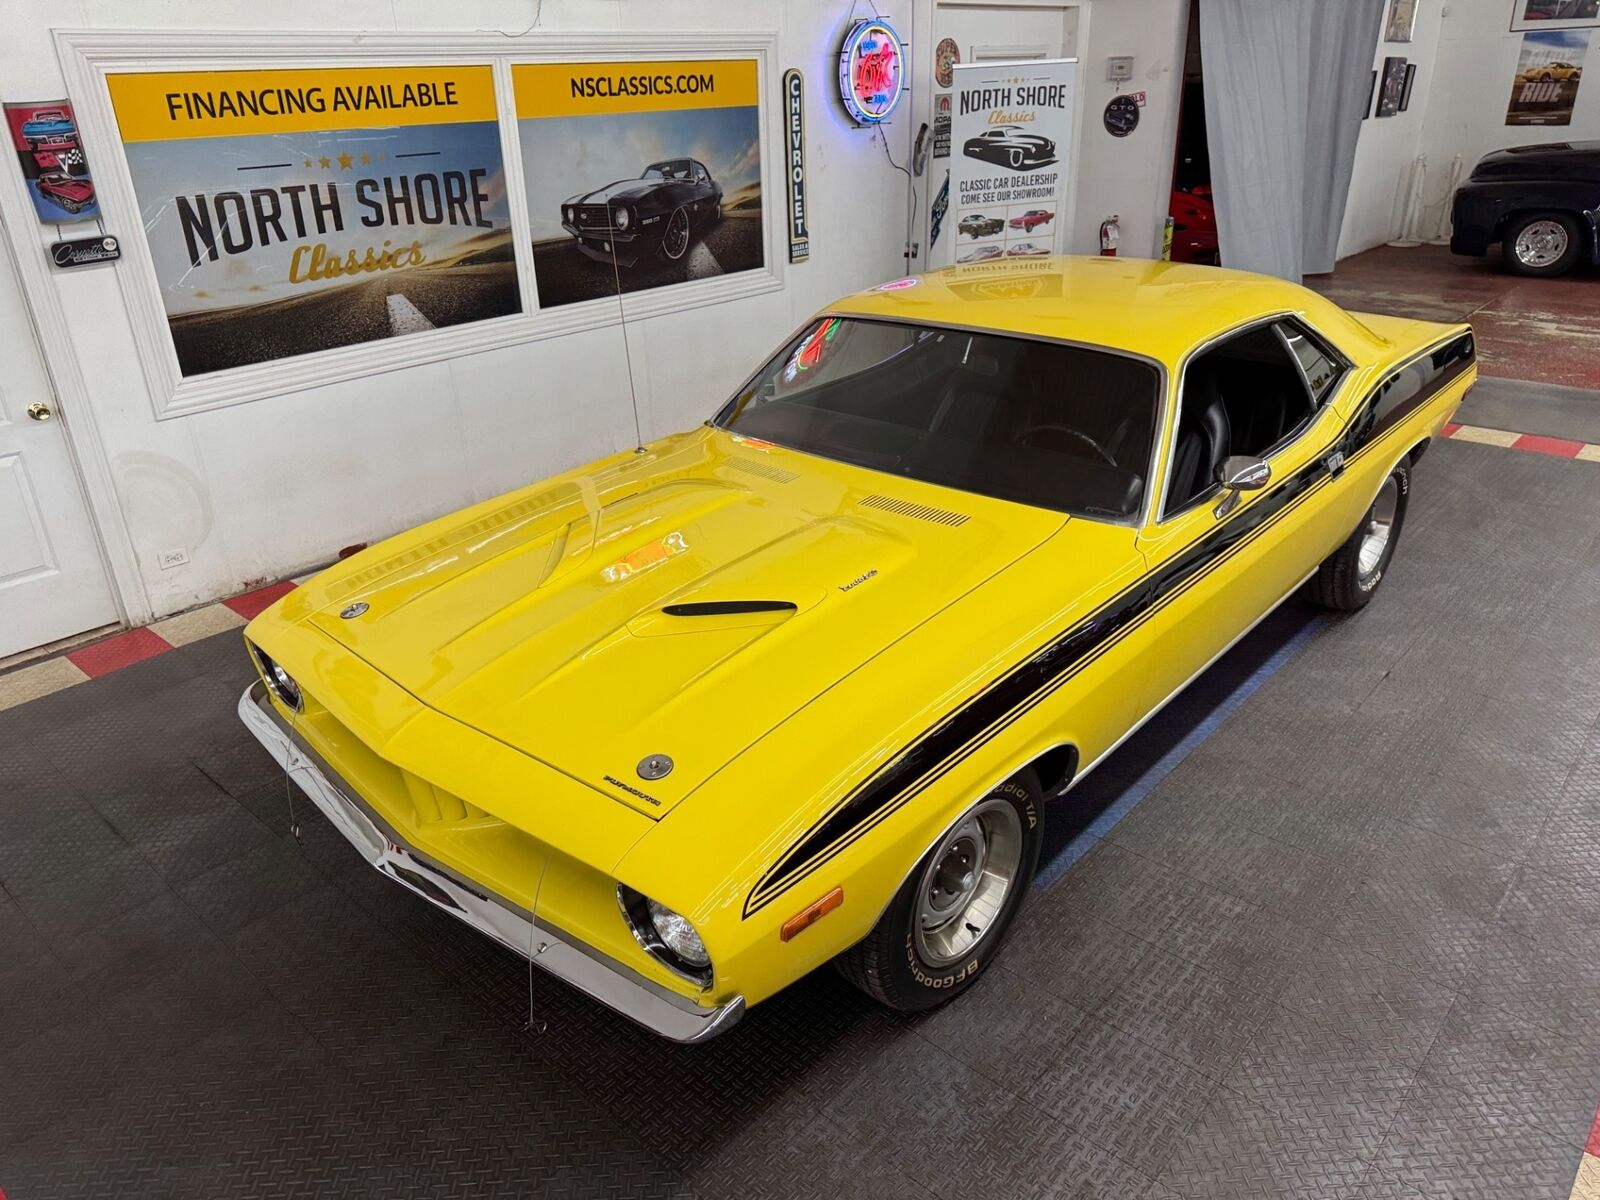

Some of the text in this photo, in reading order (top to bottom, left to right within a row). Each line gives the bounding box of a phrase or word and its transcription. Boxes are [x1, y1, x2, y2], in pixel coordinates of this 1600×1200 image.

[165, 82, 459, 120] FINANCING AVAILABLE
[570, 74, 715, 98] NSCLASSICS.COM
[960, 84, 1066, 116] NORTH SHORE
[1519, 82, 1562, 103] RIDE
[988, 109, 1035, 125] Classics
[791, 79, 803, 234] CHEVROLET
[960, 173, 1058, 192] CLASSIC CAR DEALERSHIP
[961, 187, 1055, 205] COME SEE OUR SHOWROOM!
[175, 167, 494, 268] NORTH SHORE
[288, 240, 427, 284] Classics
[994, 782, 1038, 830] adial T/A
